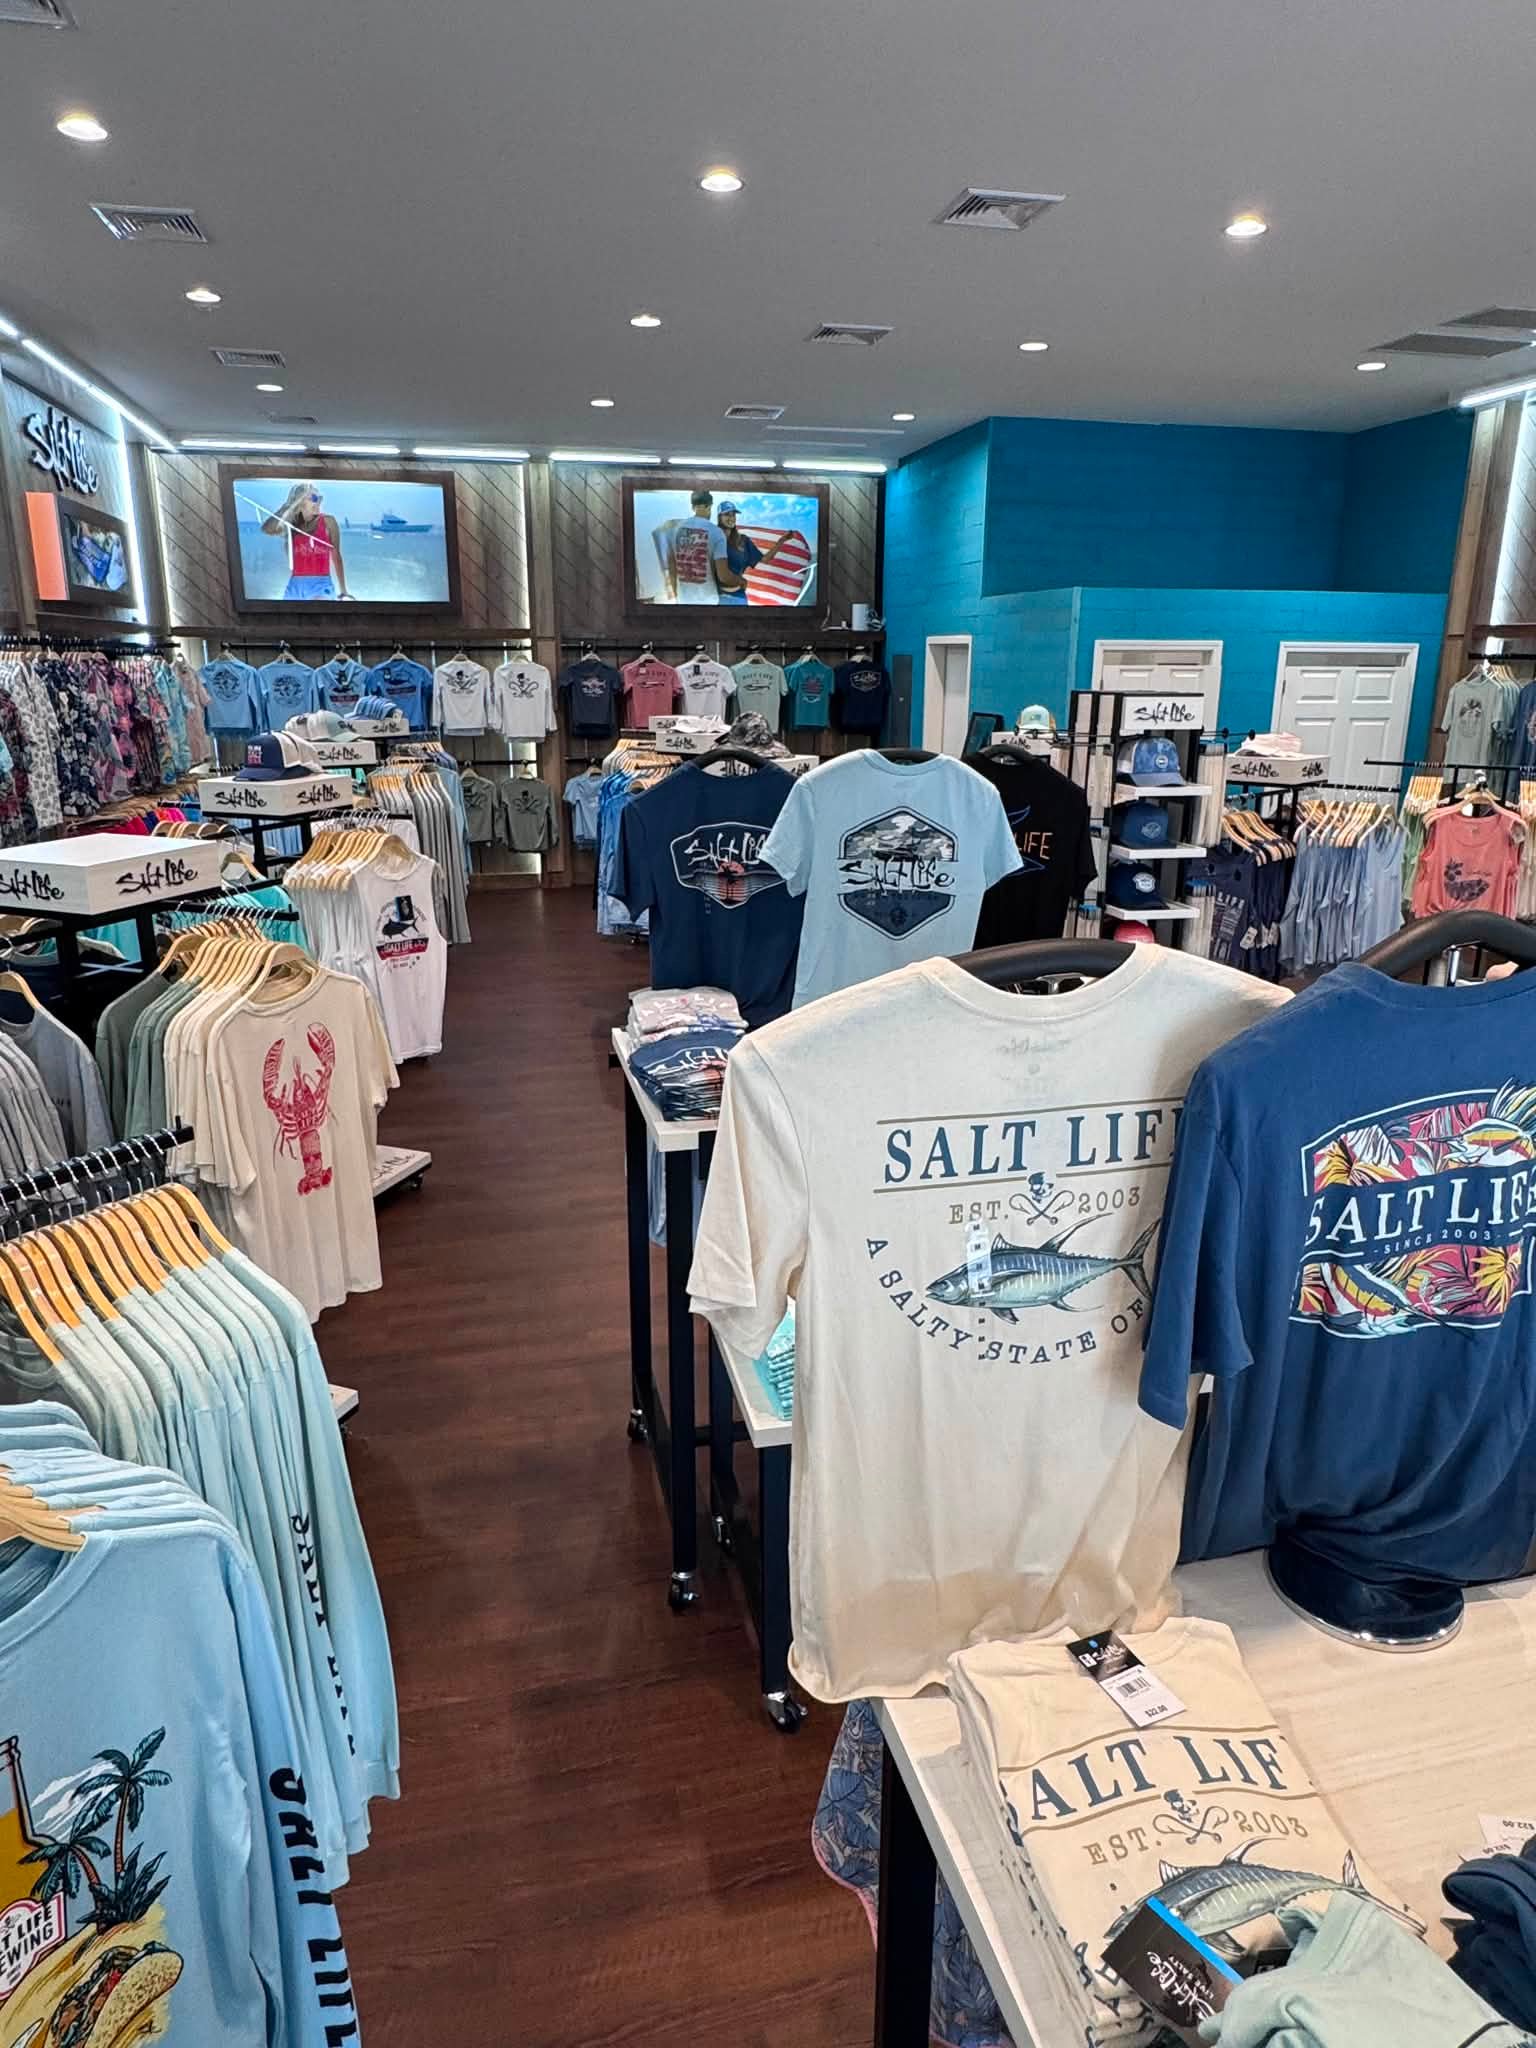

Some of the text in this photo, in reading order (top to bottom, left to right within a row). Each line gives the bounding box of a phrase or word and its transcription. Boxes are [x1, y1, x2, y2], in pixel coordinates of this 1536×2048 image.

[741, 832, 769, 864] Lif
[884, 1107, 1184, 1184] SALT LIF
[948, 1186, 1141, 1225] EST. 2003
[1304, 1184, 1434, 1247] SALT
[1441, 1229, 1491, 1241] 2003
[879, 1269, 973, 1350] SALTY
[985, 1331, 1097, 1364] STATE
[1111, 1297, 1145, 1334] OF
[1173, 1735, 1302, 1791] LIF
[1082, 1810, 1309, 1866] EST. 2003
[0, 1921, 53, 1977] EWING
[18, 1904, 52, 1940] LIFE
